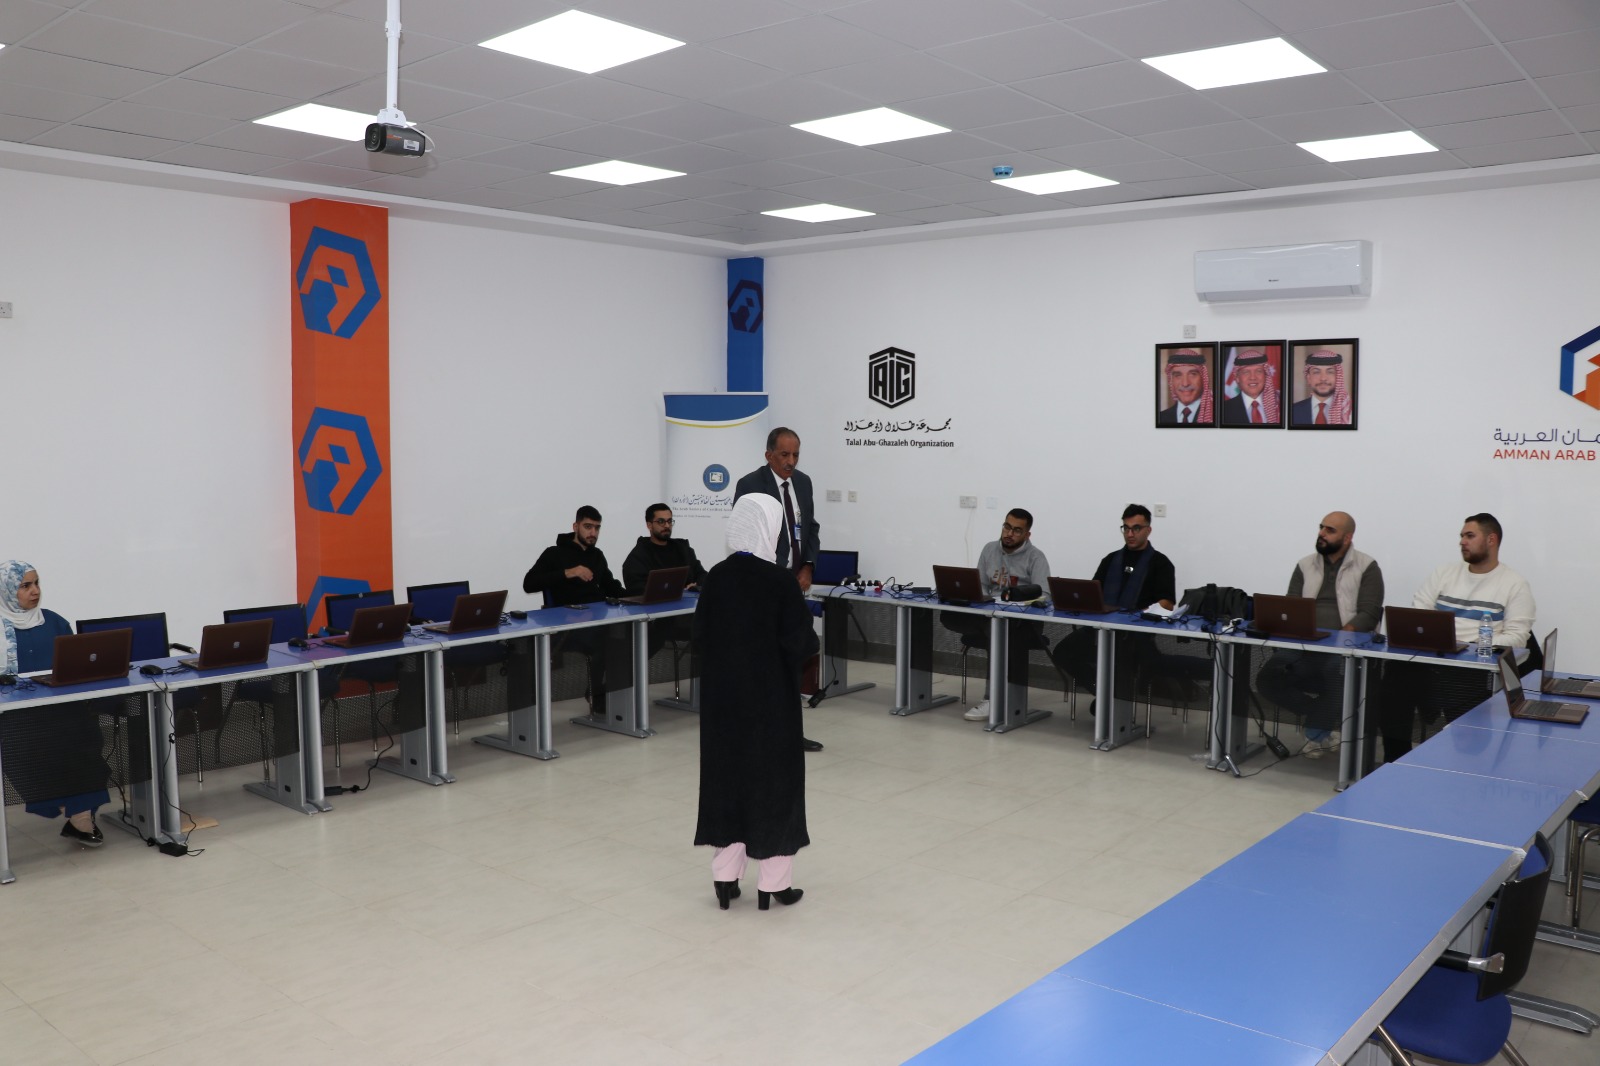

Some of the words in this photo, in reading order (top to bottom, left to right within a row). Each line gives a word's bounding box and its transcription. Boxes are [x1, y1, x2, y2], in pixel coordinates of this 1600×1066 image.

[884, 419, 916, 433] طلال
[917, 417, 952, 434] مجموعة
[846, 438, 862, 446] Talal
[863, 438, 909, 447] Abu-Ghazaleh
[910, 439, 954, 448] Organization
[1493, 428, 1559, 446] العربية
[1493, 448, 1551, 461] AMMAN
[1554, 449, 1597, 461] ARAB
